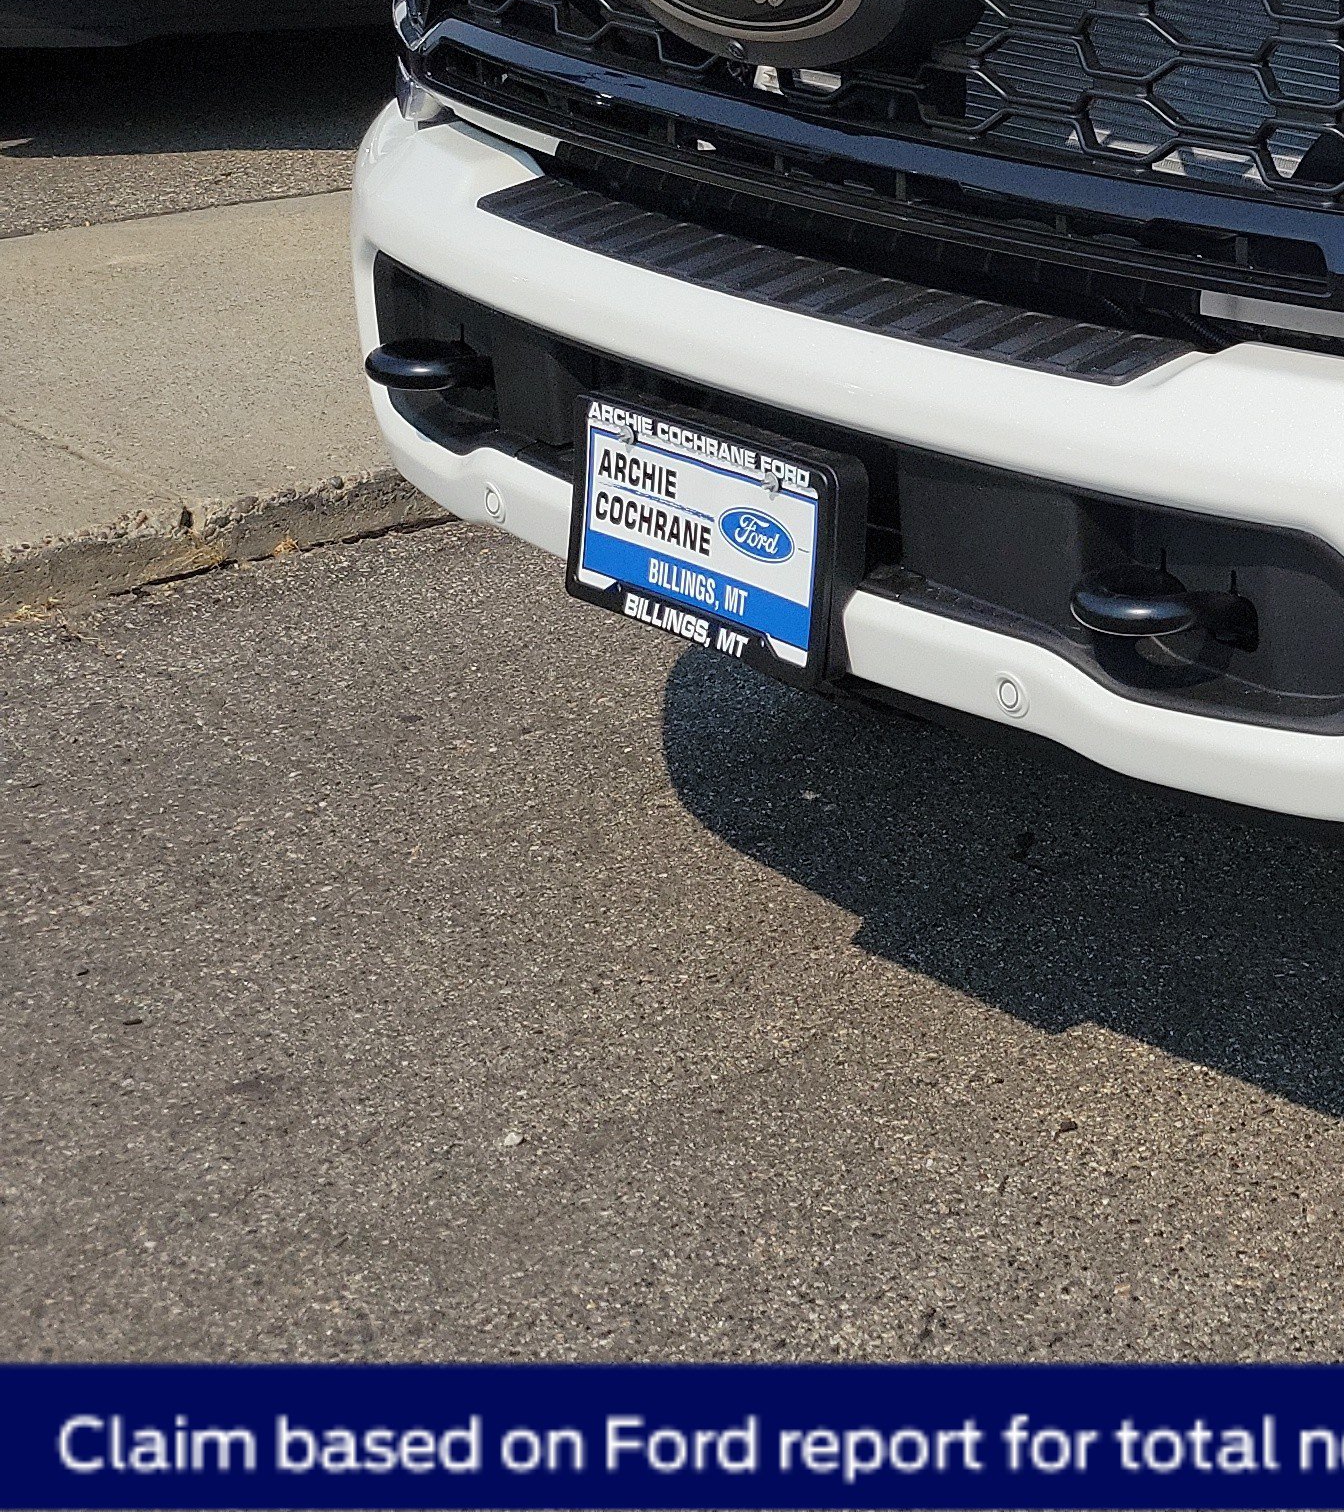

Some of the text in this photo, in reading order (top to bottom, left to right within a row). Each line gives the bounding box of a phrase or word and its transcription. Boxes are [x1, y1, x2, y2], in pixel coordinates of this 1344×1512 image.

[589, 401, 811, 487] ARCHIE COCHRANE FORD
[597, 449, 678, 499] ARCHIE
[595, 491, 712, 557] COCHRANE
[734, 514, 780, 556] Ford
[648, 557, 748, 617] BILLINGS, MT
[623, 594, 750, 658] BILLINGS, MT
